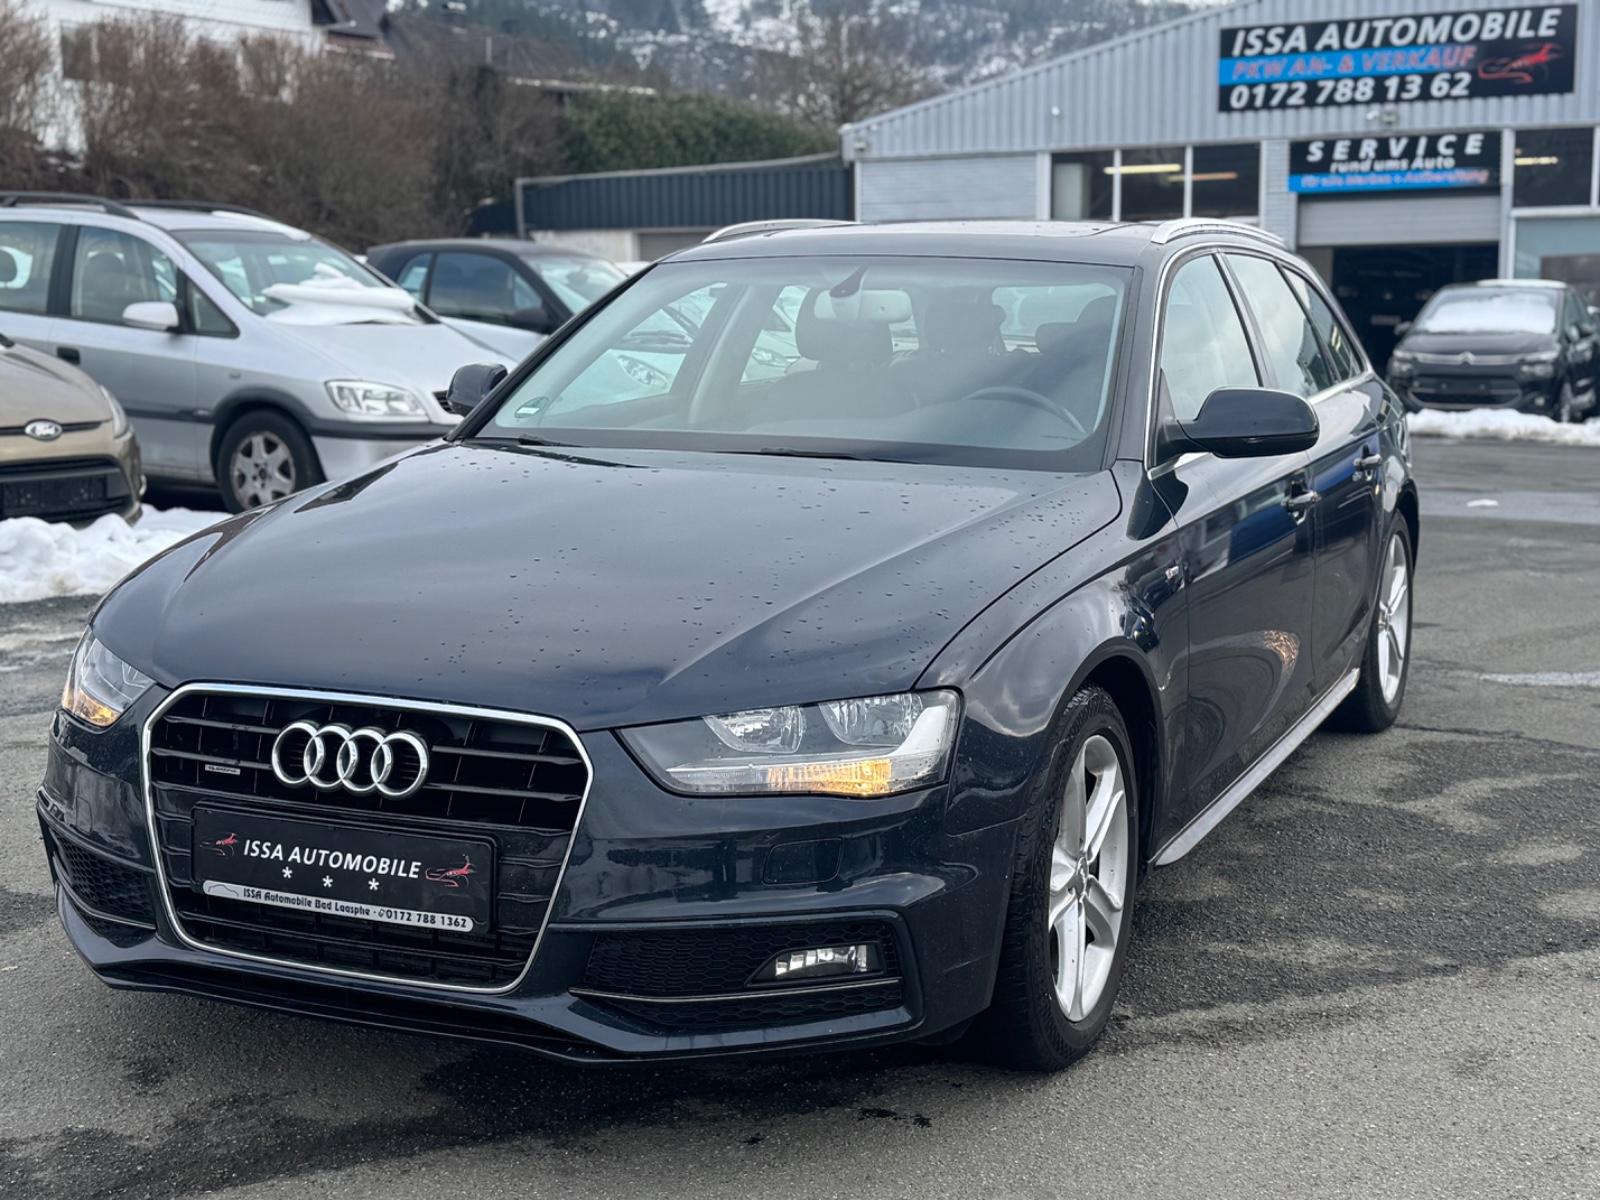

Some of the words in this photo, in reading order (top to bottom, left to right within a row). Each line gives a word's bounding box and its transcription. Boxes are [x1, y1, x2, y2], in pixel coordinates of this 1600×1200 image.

[1232, 26, 1307, 57] ISSA
[1315, 8, 1562, 50] AUTOMOBILE
[1232, 58, 1287, 80] PKW
[1338, 54, 1354, 74] &
[1362, 45, 1477, 72] VERKAUF
[1230, 80, 1307, 109] 0172
[1316, 77, 1375, 104] 788
[1384, 74, 1423, 101] 13
[1430, 71, 1472, 98] 62
[1306, 133, 1485, 162] SERVICE
[1329, 158, 1372, 174] rund
[1411, 155, 1456, 170] Auto
[243, 839, 284, 861] ISSA
[288, 846, 422, 879] AUTOMOBILE
[243, 887, 262, 900] ISSA
[264, 891, 312, 908] Automobile
[315, 898, 332, 911] Bad
[385, 909, 412, 922] 0172
[416, 913, 436, 924] 788
[440, 916, 467, 928] 1362
